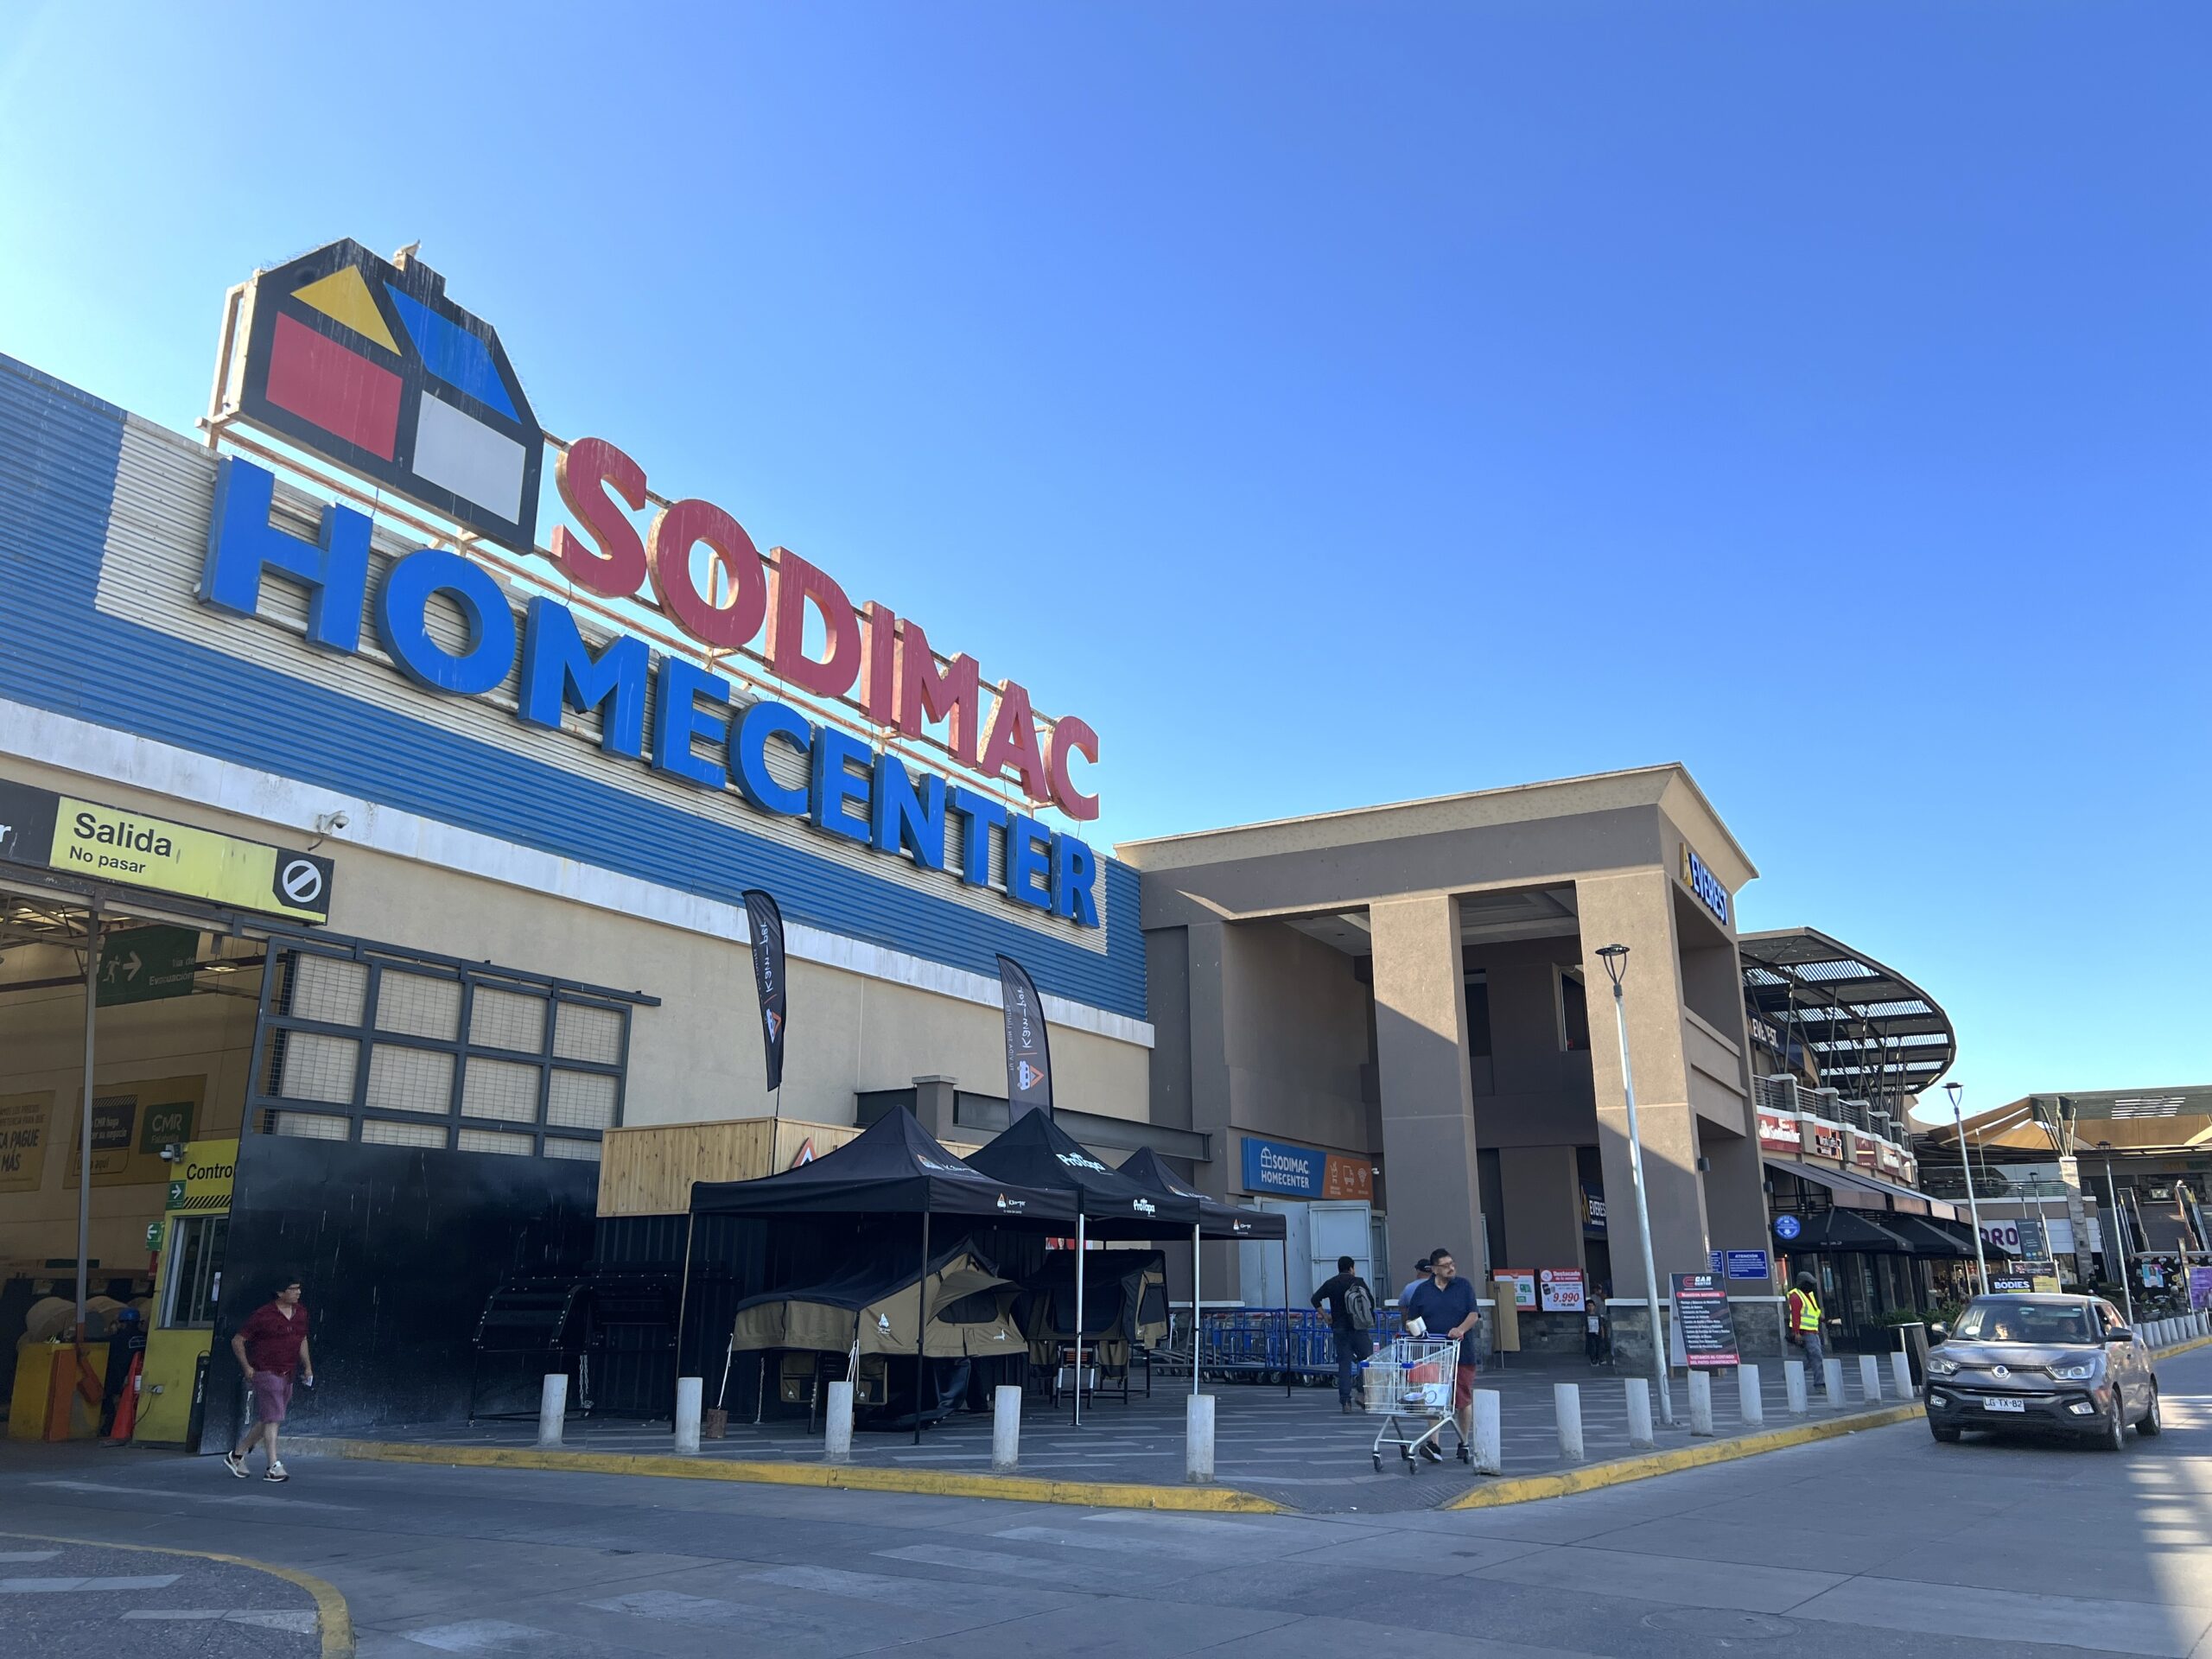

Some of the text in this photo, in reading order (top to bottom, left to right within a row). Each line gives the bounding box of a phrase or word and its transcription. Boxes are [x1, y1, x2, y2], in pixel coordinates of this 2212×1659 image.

[551, 436, 1100, 821] SODIMAC
[198, 455, 1099, 928] HOMECENTER
[73, 812, 173, 858] Salida
[70, 845, 146, 874] No pasar
[1688, 852, 1729, 925] EVEREST
[152, 1114, 182, 1132] CMR
[10, 1128, 40, 1148] PAGUE
[1272, 1154, 1309, 1174] SODIMAC
[1261, 1170, 1310, 1189] HOMECENTER
[1994, 1281, 2030, 1289] BODIES
[1553, 1292, 1580, 1302] 9.990
